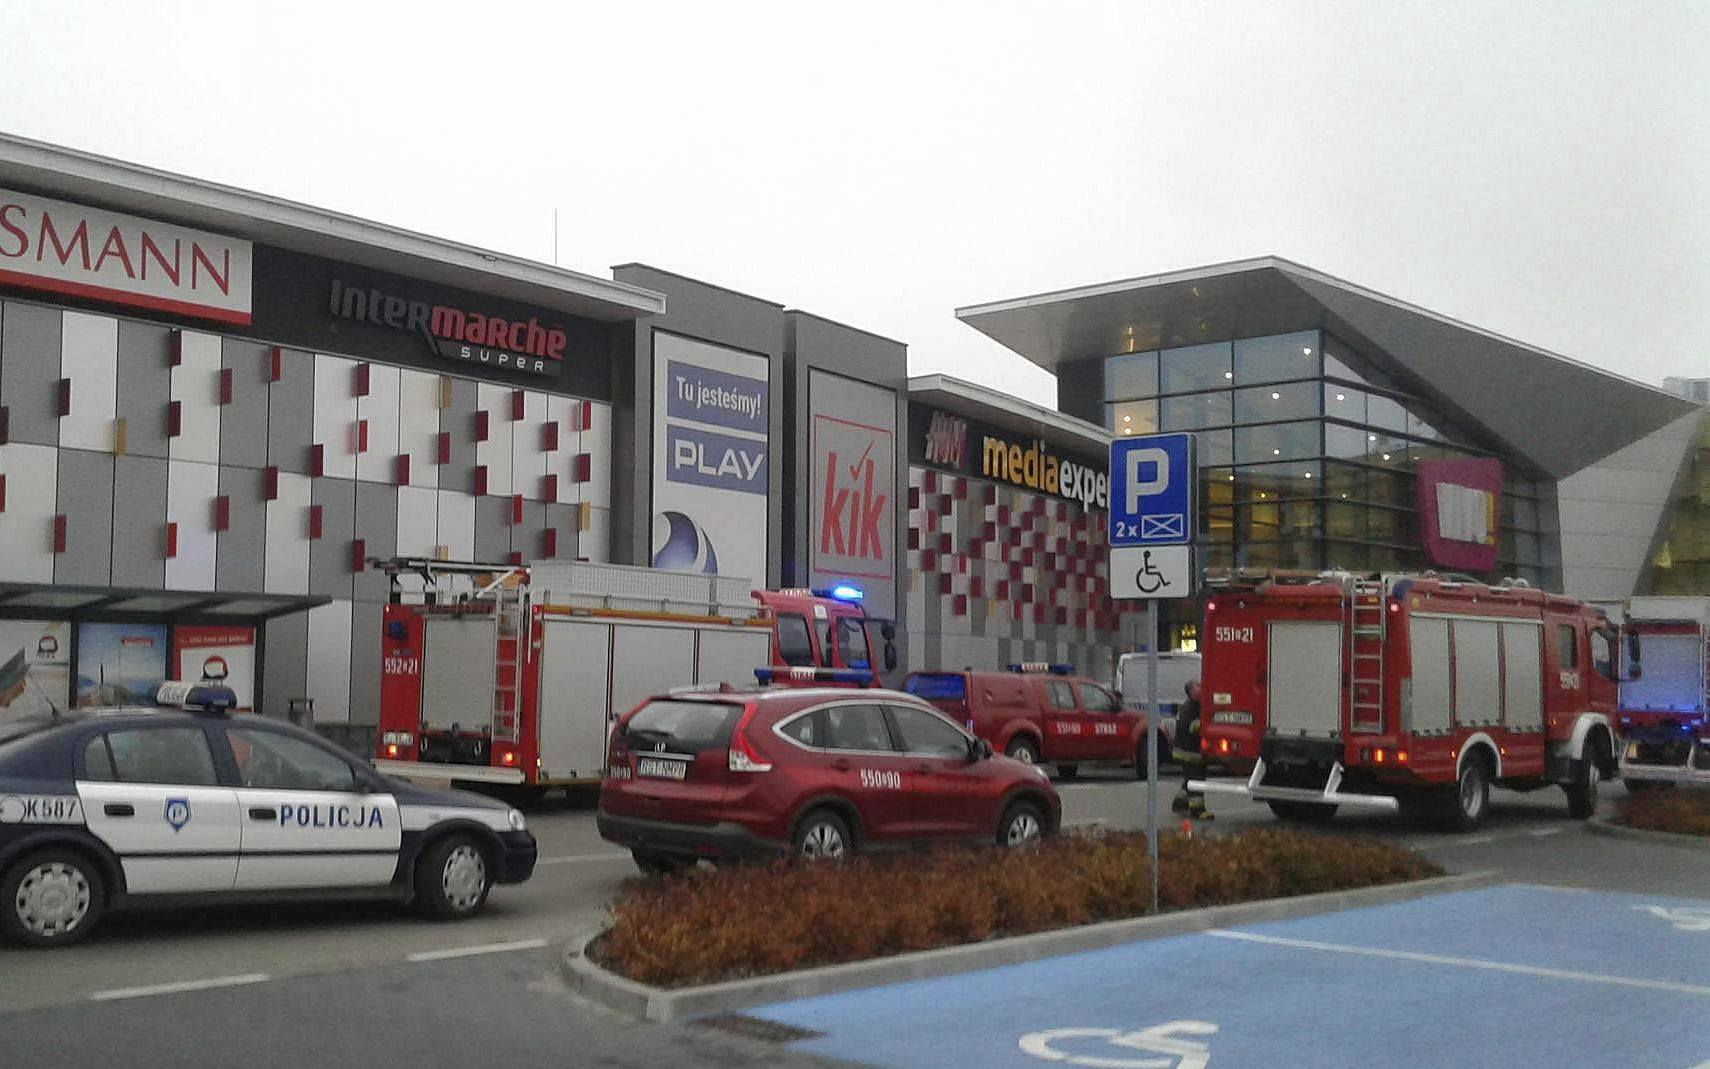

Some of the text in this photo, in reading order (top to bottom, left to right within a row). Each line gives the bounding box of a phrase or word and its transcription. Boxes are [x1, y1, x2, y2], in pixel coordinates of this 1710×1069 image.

[0, 204, 230, 296] SMANN
[461, 346, 543, 373] SUPER
[676, 376, 760, 419] Tu jesteśmy!
[674, 438, 764, 481] PLAY
[983, 435, 1111, 513] mediaexpe
[1126, 448, 1169, 515] P
[280, 805, 384, 828] POLICJA
